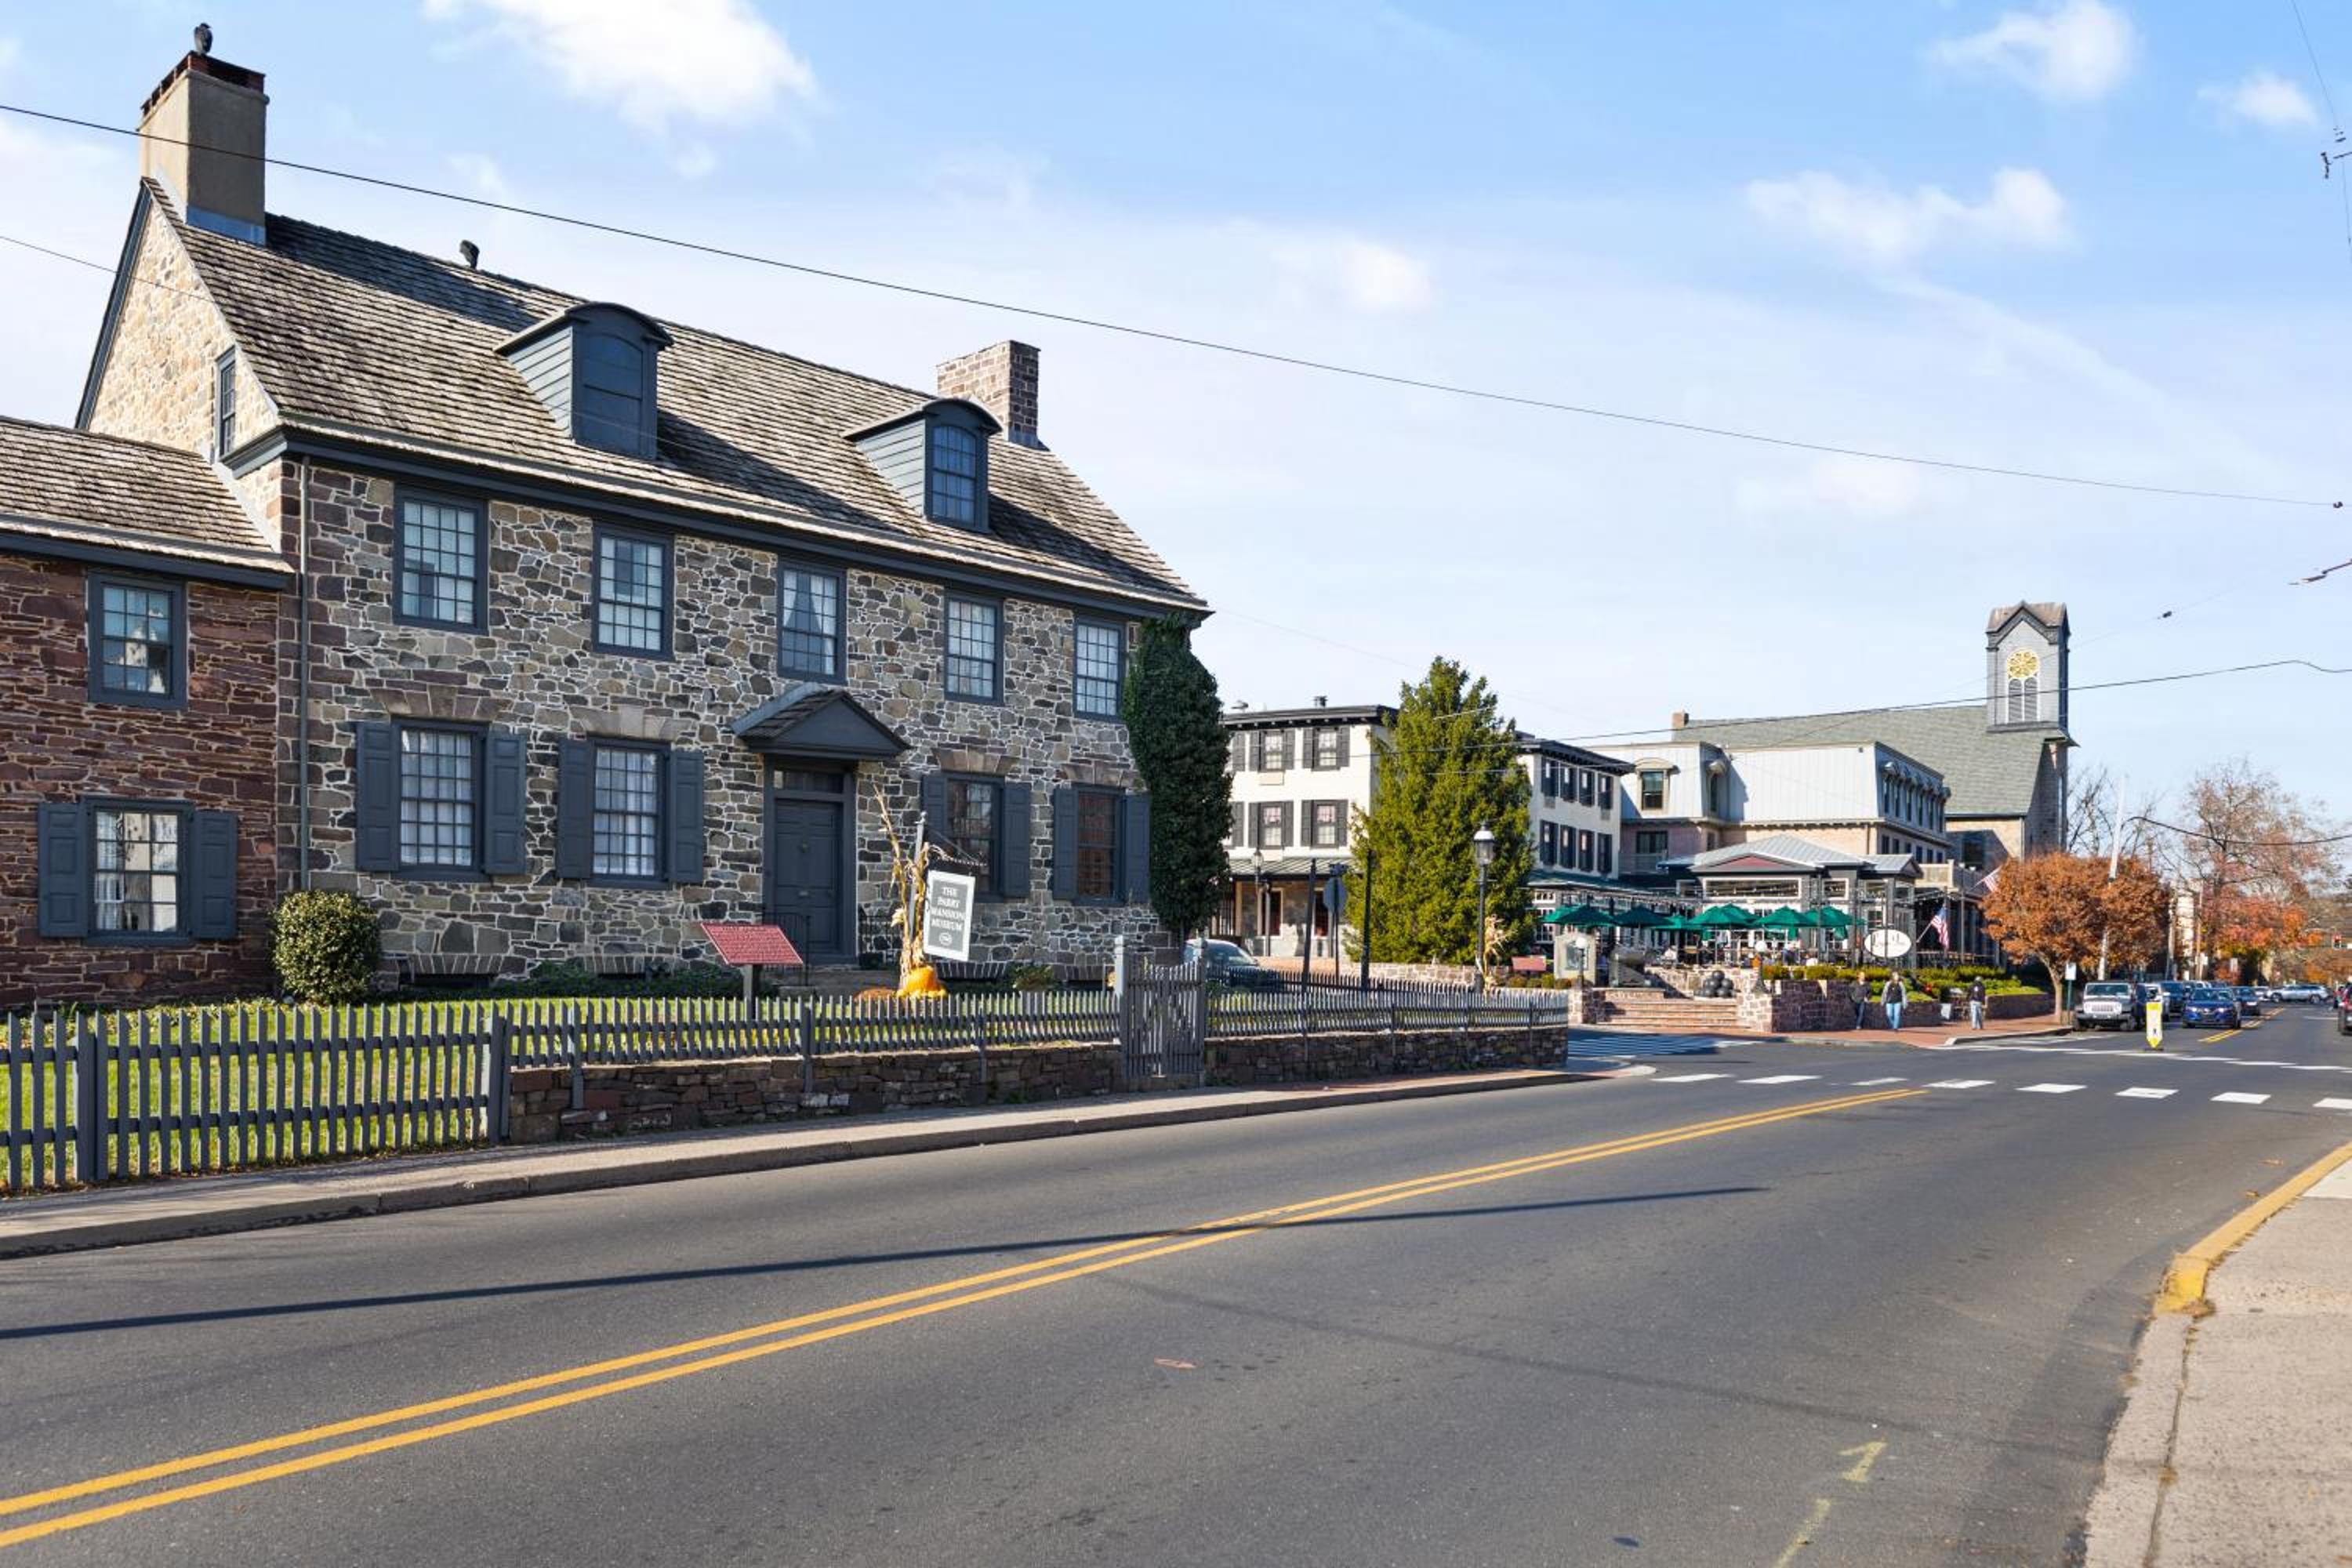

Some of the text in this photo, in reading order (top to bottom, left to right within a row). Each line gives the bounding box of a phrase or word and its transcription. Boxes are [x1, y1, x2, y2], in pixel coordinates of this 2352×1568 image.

[942, 887, 958, 897] THE
[931, 906, 965, 920] MANSION
[931, 917, 963, 931] MUSEUM
